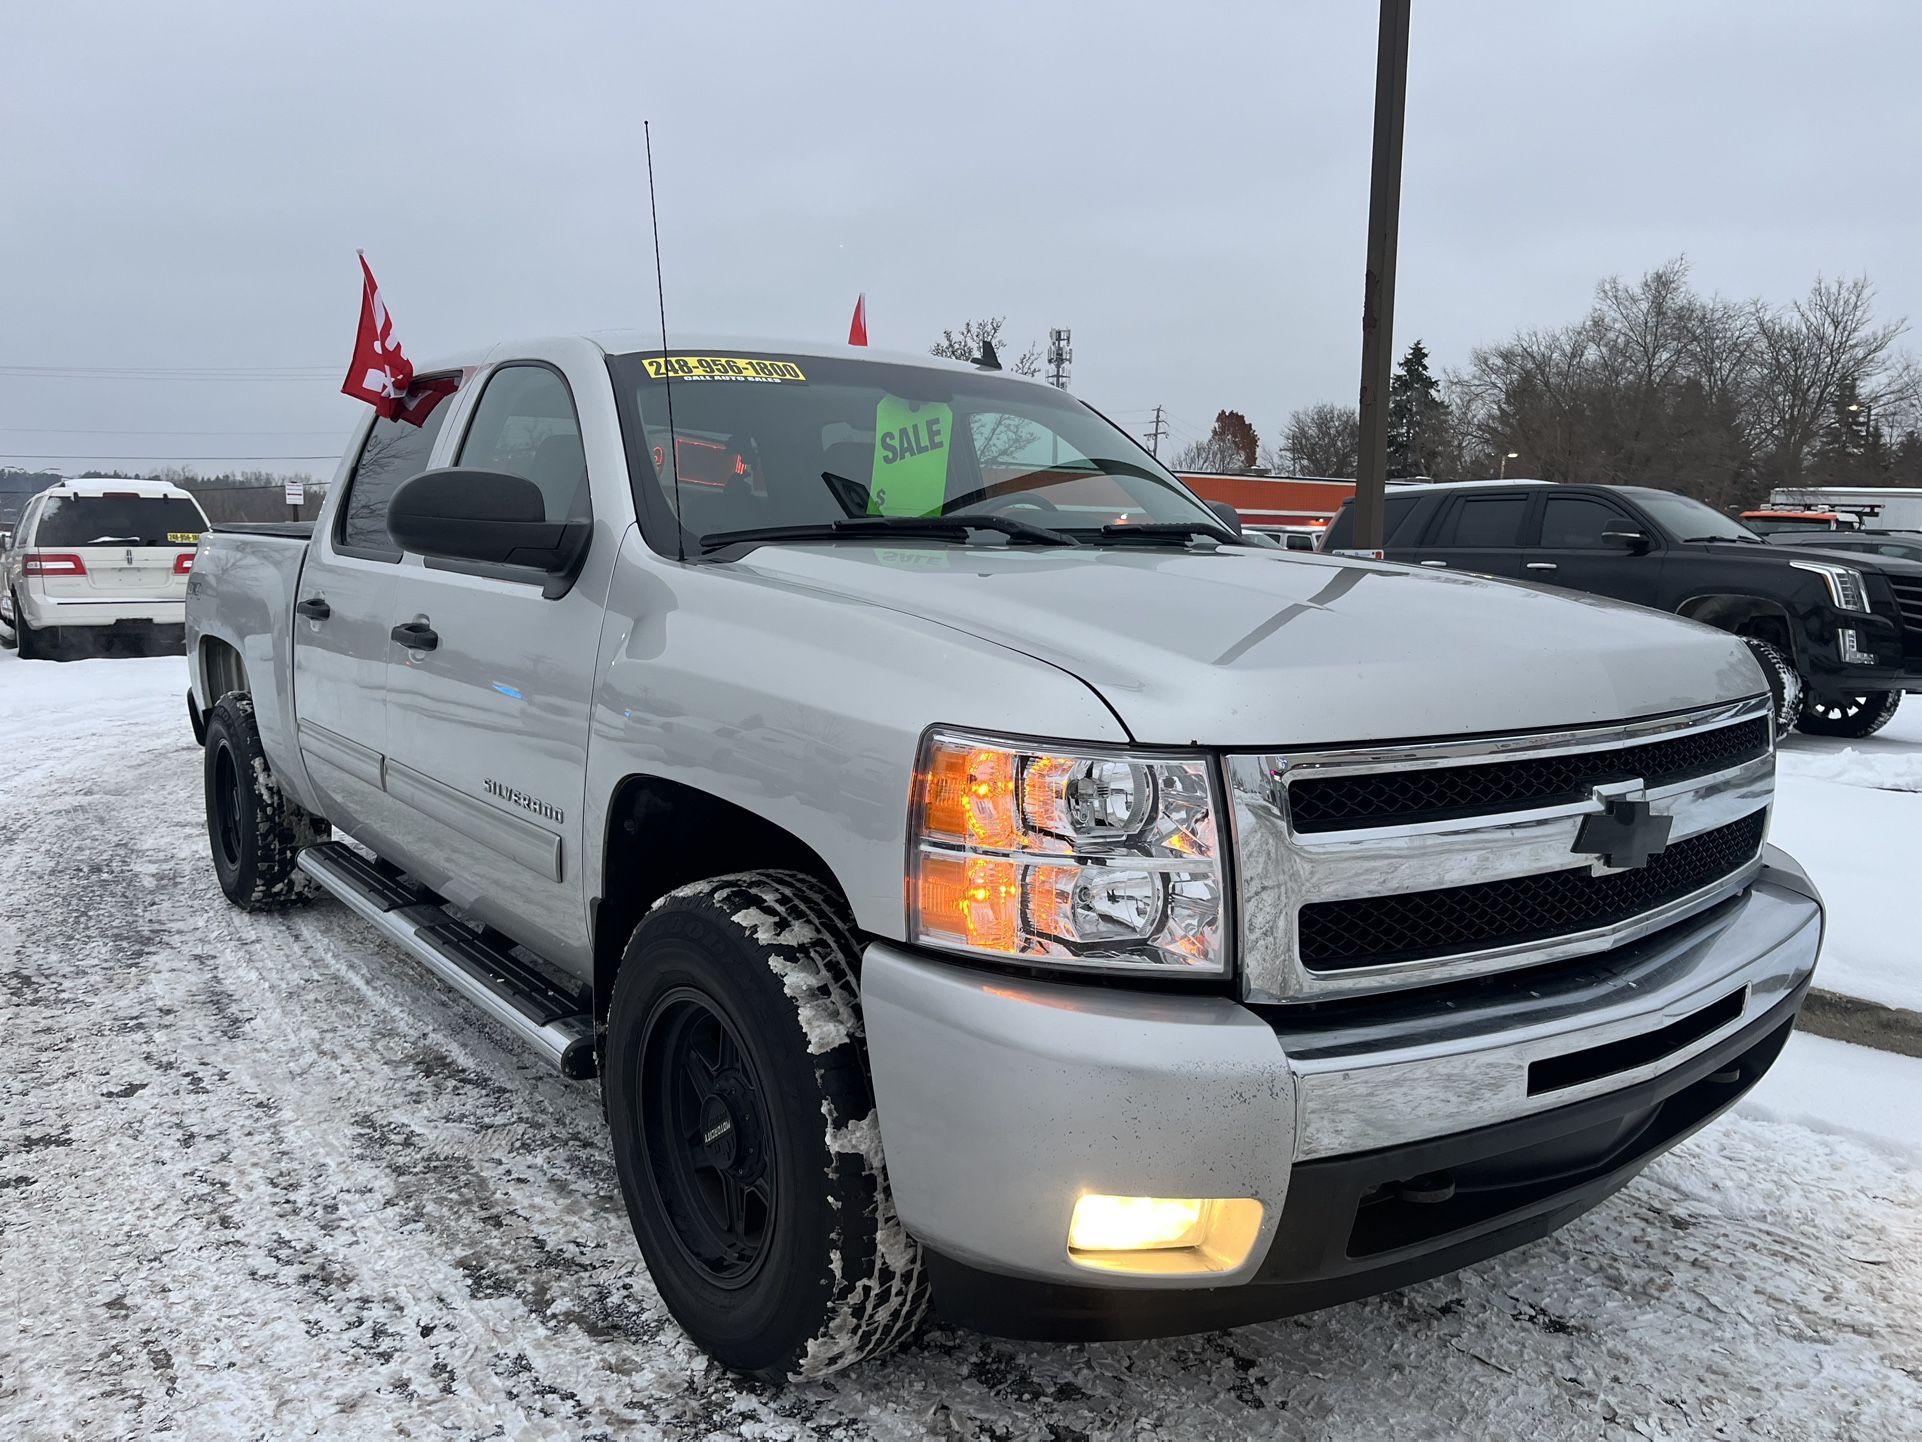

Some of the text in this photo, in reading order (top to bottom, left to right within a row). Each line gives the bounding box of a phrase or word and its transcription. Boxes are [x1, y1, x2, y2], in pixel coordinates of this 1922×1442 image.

[649, 358, 800, 379] 248-956-1800
[880, 418, 944, 464] SALE
[875, 487, 886, 507] $
[483, 778, 564, 824] SILVERADO
